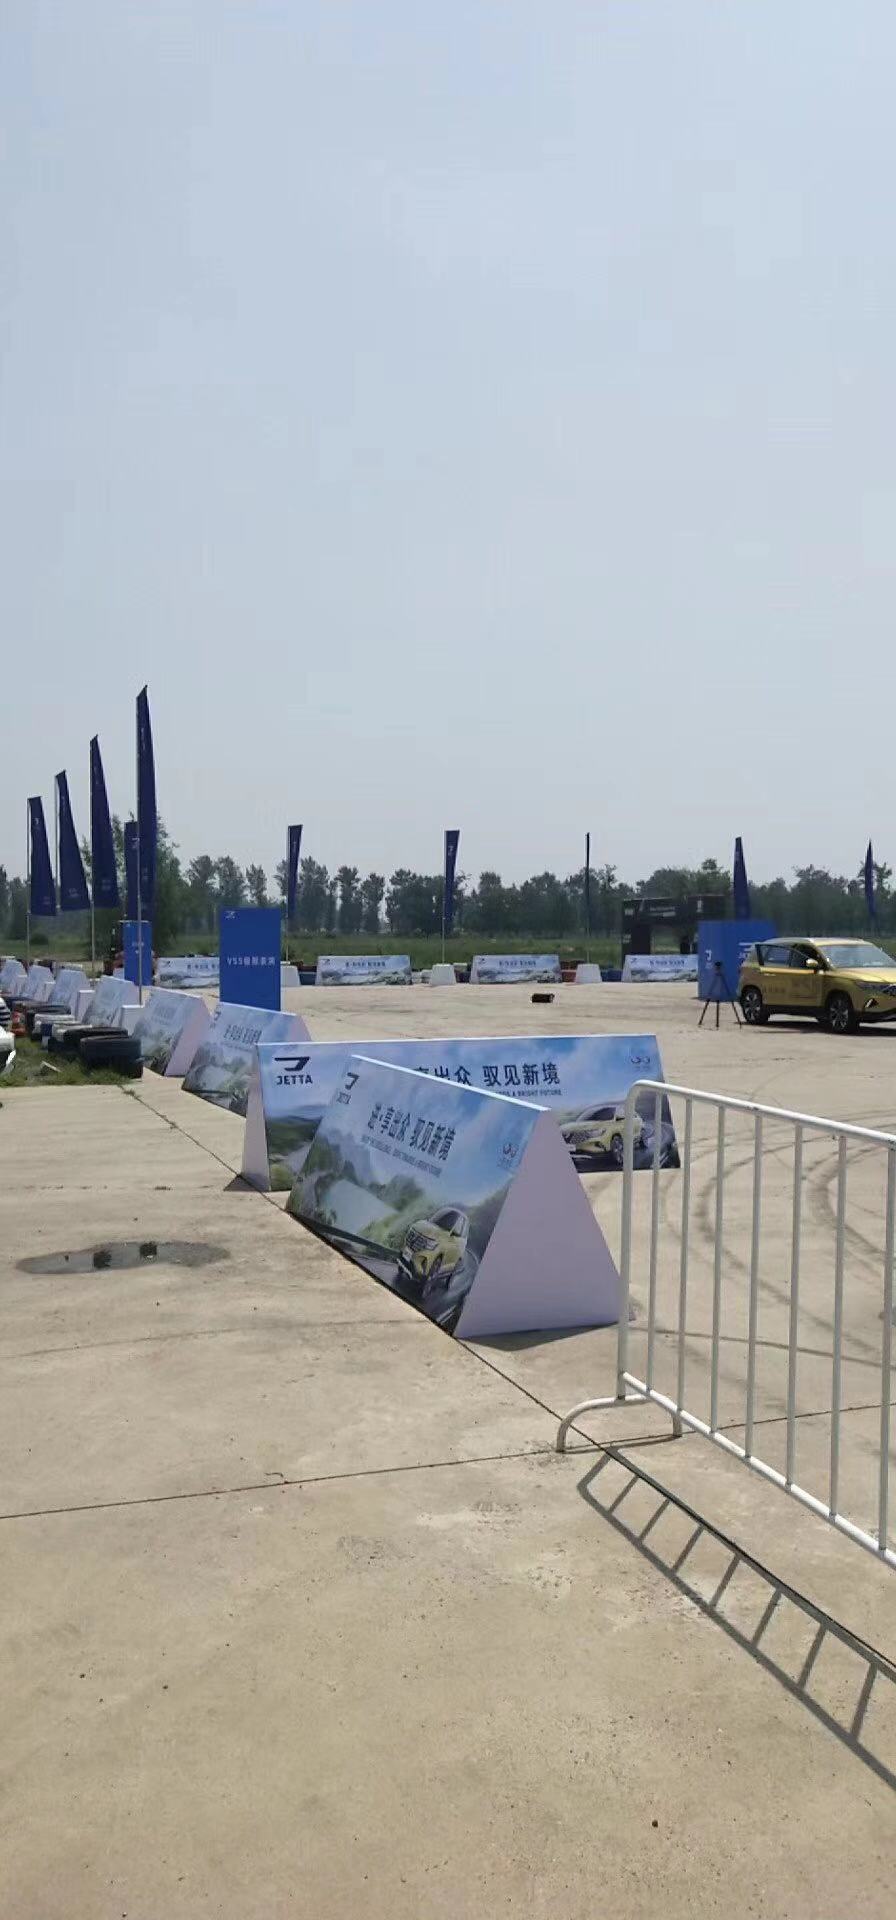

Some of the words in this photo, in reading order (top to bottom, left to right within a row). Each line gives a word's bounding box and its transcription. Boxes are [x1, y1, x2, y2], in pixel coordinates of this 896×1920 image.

[276, 1074, 313, 1085] JETTA
[482, 1061, 560, 1086] 驭见新境
